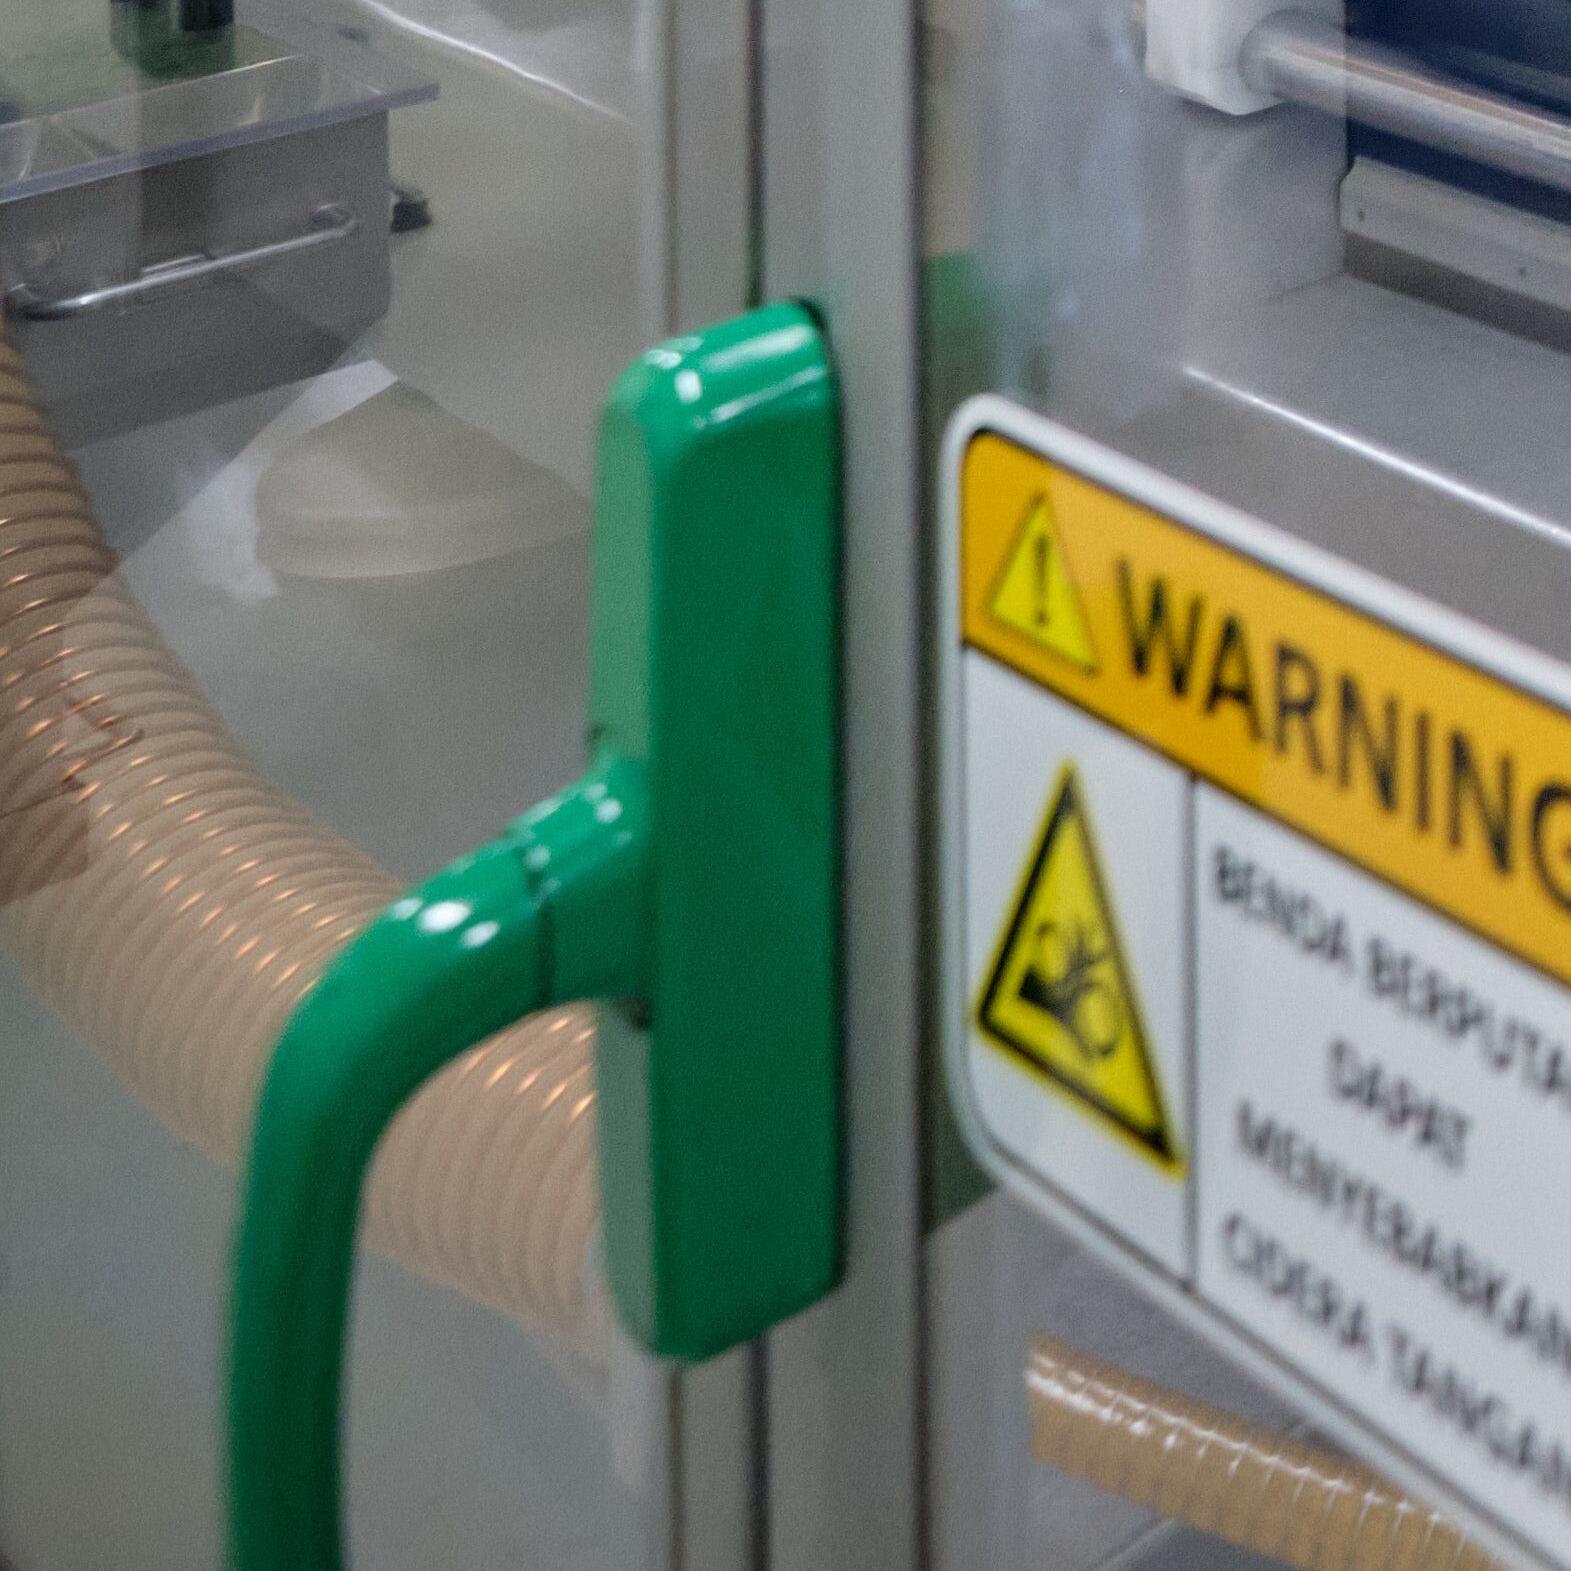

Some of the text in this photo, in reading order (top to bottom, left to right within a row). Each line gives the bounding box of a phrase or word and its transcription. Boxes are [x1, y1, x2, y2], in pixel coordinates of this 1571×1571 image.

[1216, 844, 1353, 979] BENDA
[1328, 1036, 1471, 1170] DAPAT
[1221, 1213, 1375, 1364] CIDERA
